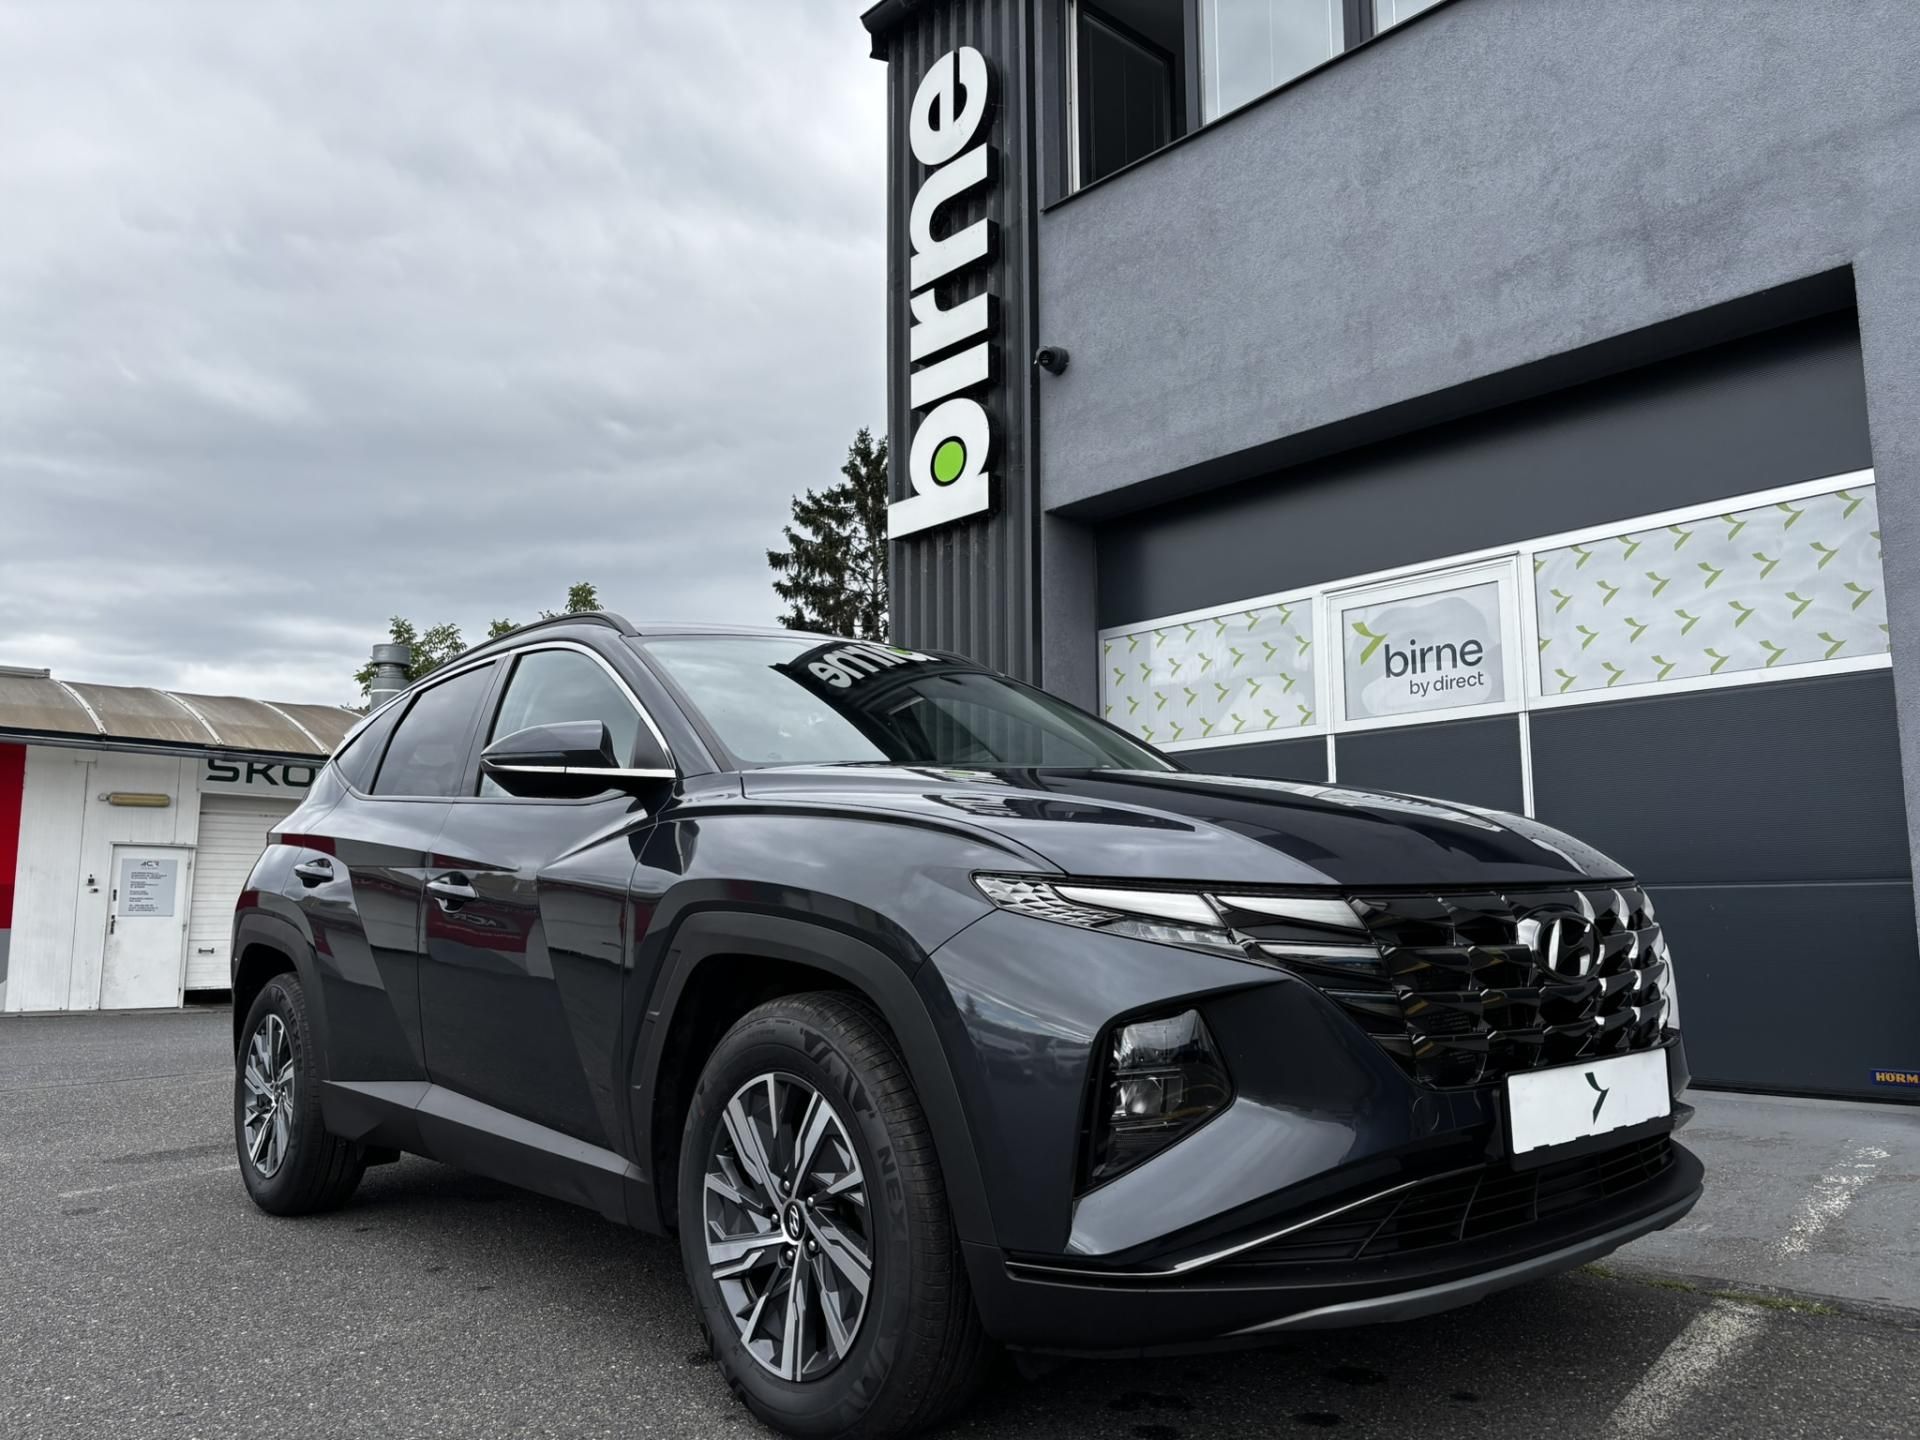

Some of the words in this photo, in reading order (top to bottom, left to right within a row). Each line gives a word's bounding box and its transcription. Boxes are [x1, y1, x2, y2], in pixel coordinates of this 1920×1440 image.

[888, 46, 991, 540] birne
[1384, 639, 1483, 678] birne
[1410, 680, 1430, 697] by
[1433, 671, 1484, 691] direct
